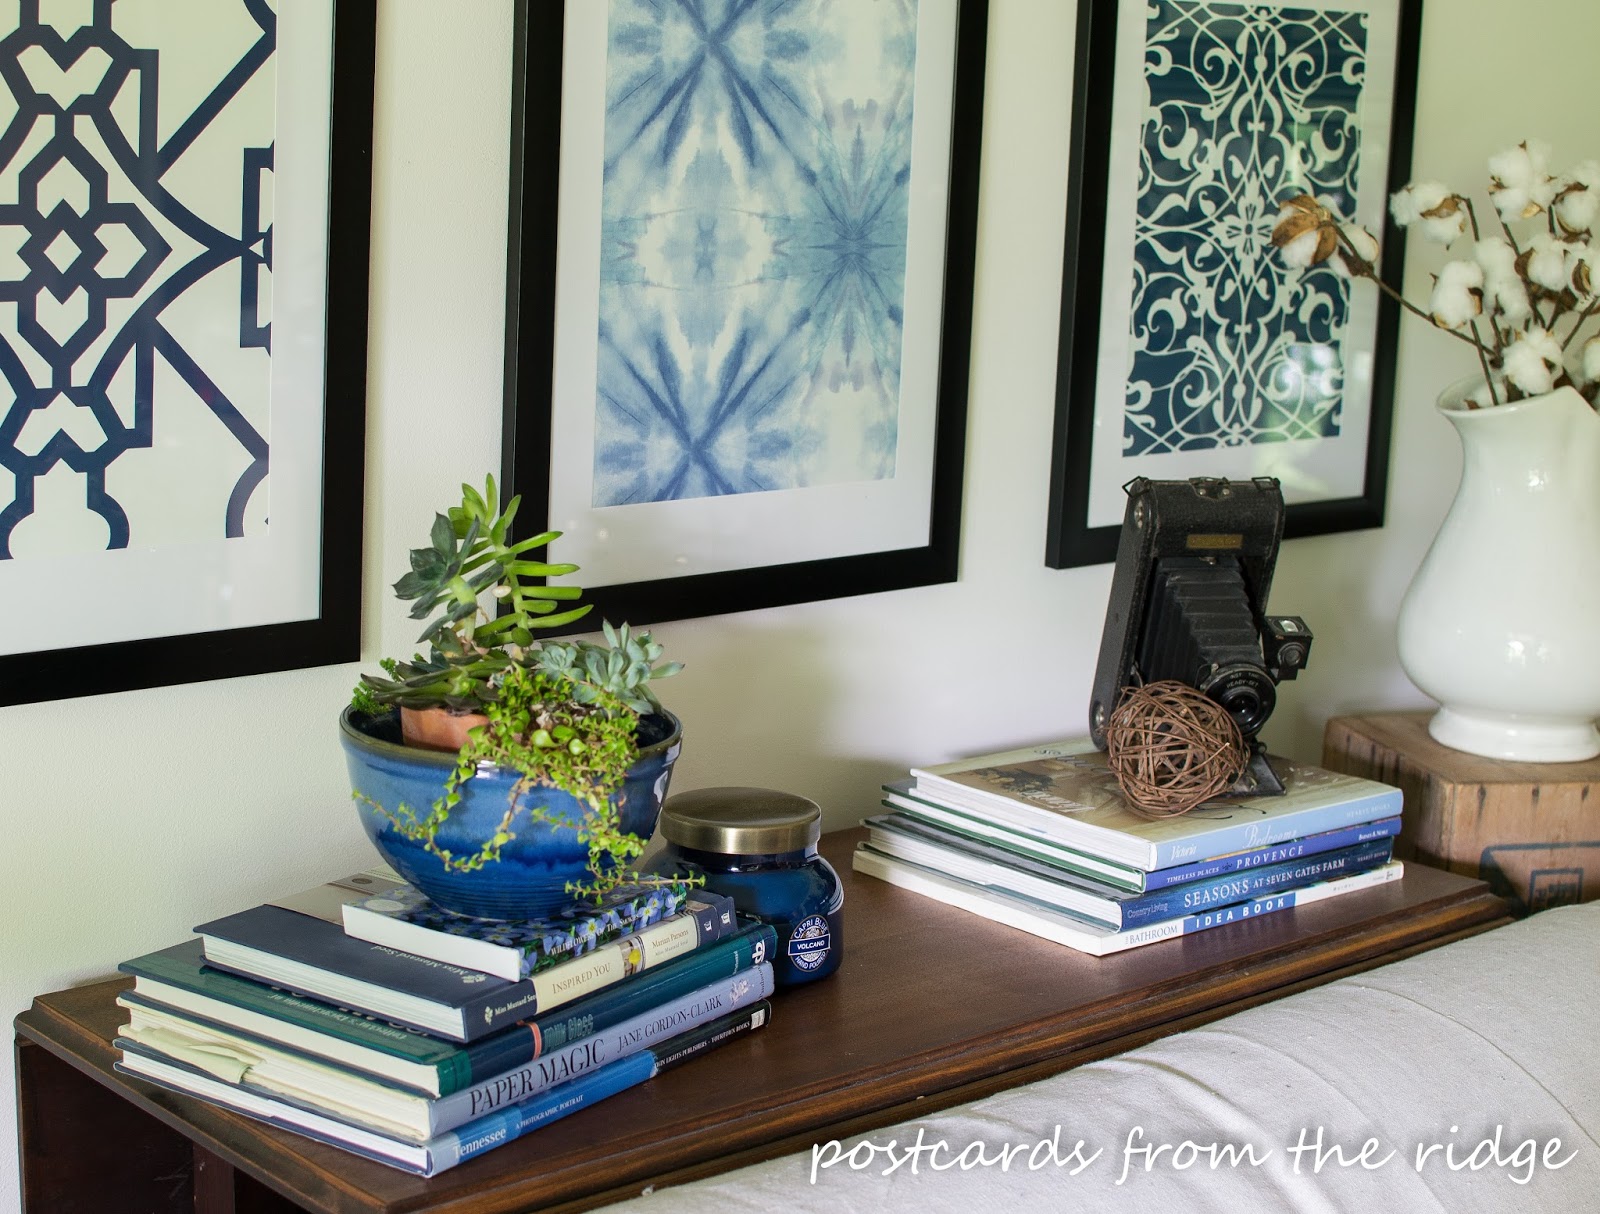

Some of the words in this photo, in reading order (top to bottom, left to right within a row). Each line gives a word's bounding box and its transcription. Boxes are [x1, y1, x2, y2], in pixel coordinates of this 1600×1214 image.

[1171, 844, 1197, 861] Victoria
[1243, 824, 1297, 848] Bedrooms
[1167, 872, 1196, 883] TIMELESS
[1197, 867, 1219, 878] PLACES
[1236, 845, 1304, 869] PROVENCE
[1184, 879, 1249, 908] SEASONS
[1253, 877, 1263, 889] AT
[1266, 870, 1293, 887] SEVEN
[1295, 864, 1321, 879] GATES
[1322, 858, 1345, 873] FARM
[794, 919, 813, 939] CAPRI
[1129, 925, 1178, 943] BATHROOM
[1196, 910, 1233, 928] IDEA
[1242, 898, 1284, 917] BOOK
[797, 940, 825, 950] VOLCANO
[552, 970, 593, 994] INSPIRED
[594, 962, 611, 977] YOU
[469, 1068, 533, 1116] PAPER
[538, 1039, 606, 1088] MAGIC
[617, 1027, 643, 1053] JANE
[644, 994, 722, 1038] GORDON-CLARK
[453, 1126, 507, 1159] Tennessee
[521, 1105, 558, 1128] PHOTOGRAPHIC
[559, 1094, 584, 1110] PORTRAIT
